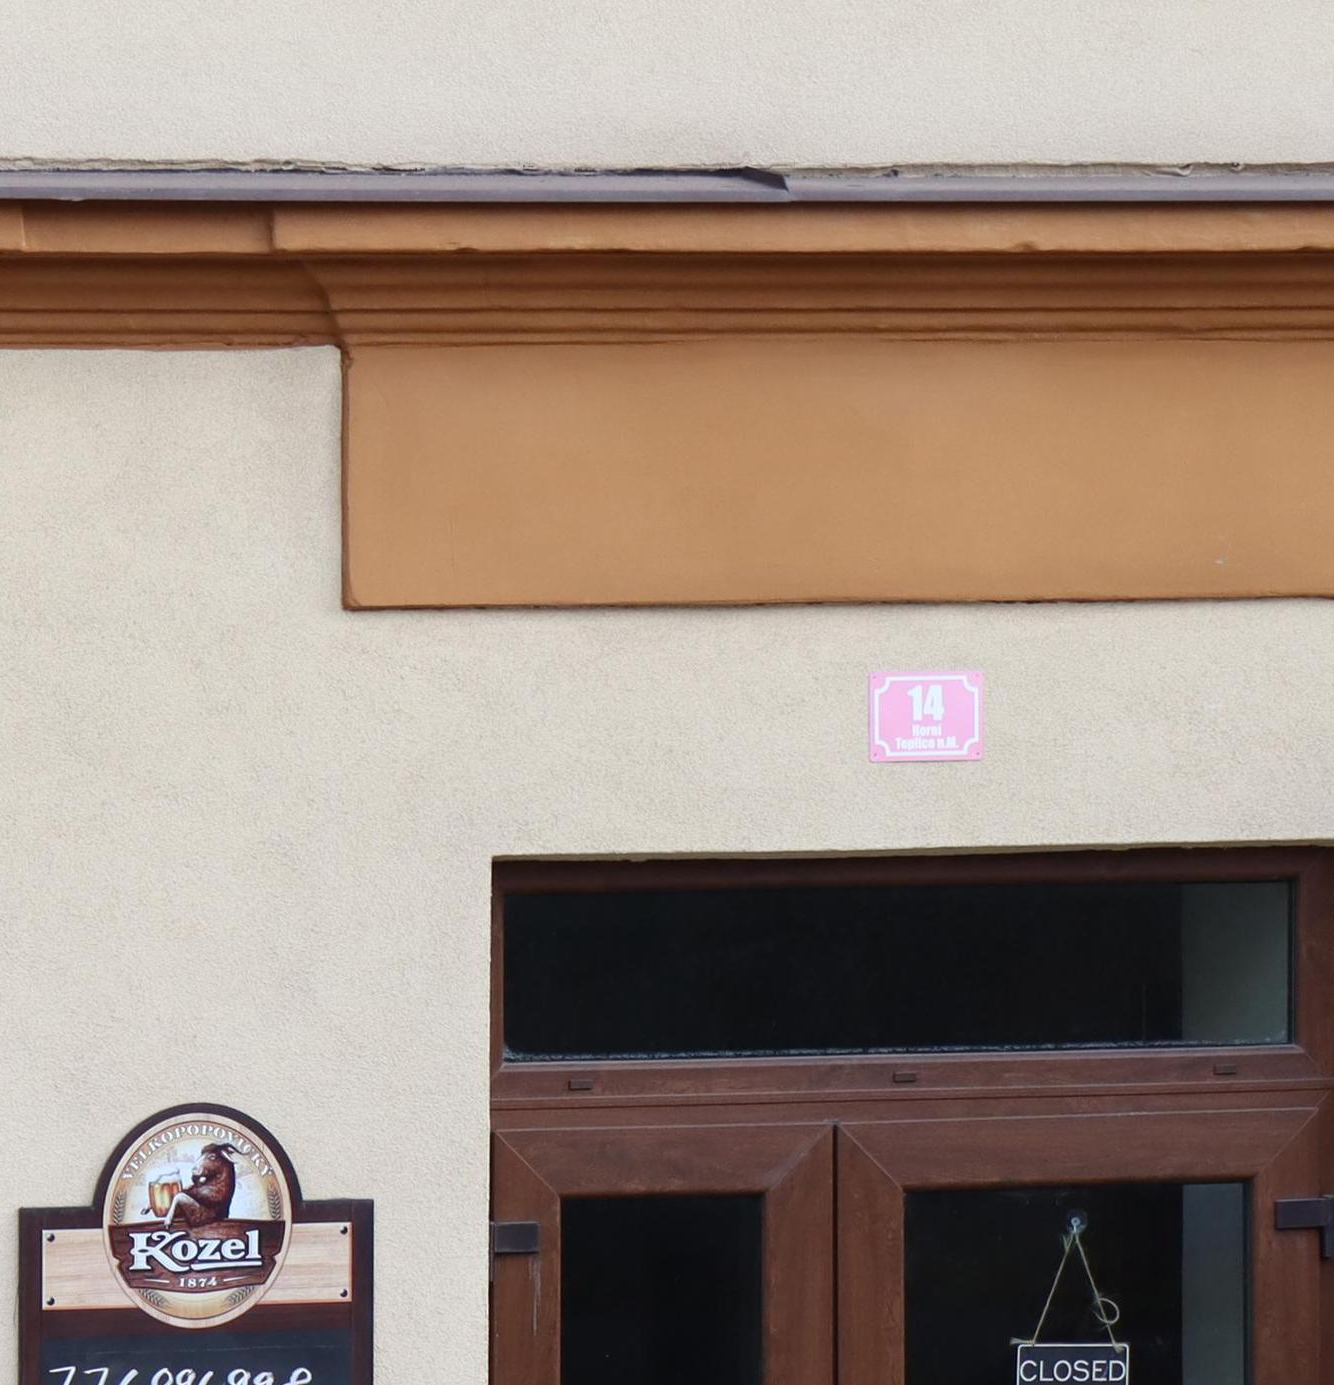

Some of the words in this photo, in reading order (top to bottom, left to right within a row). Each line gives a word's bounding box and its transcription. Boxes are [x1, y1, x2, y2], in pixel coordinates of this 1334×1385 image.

[906, 684, 945, 721] 14
[129, 1230, 262, 1272] Kozel
[179, 1276, 218, 1288] 1874
[1020, 1360, 1126, 1382] CLOSED
